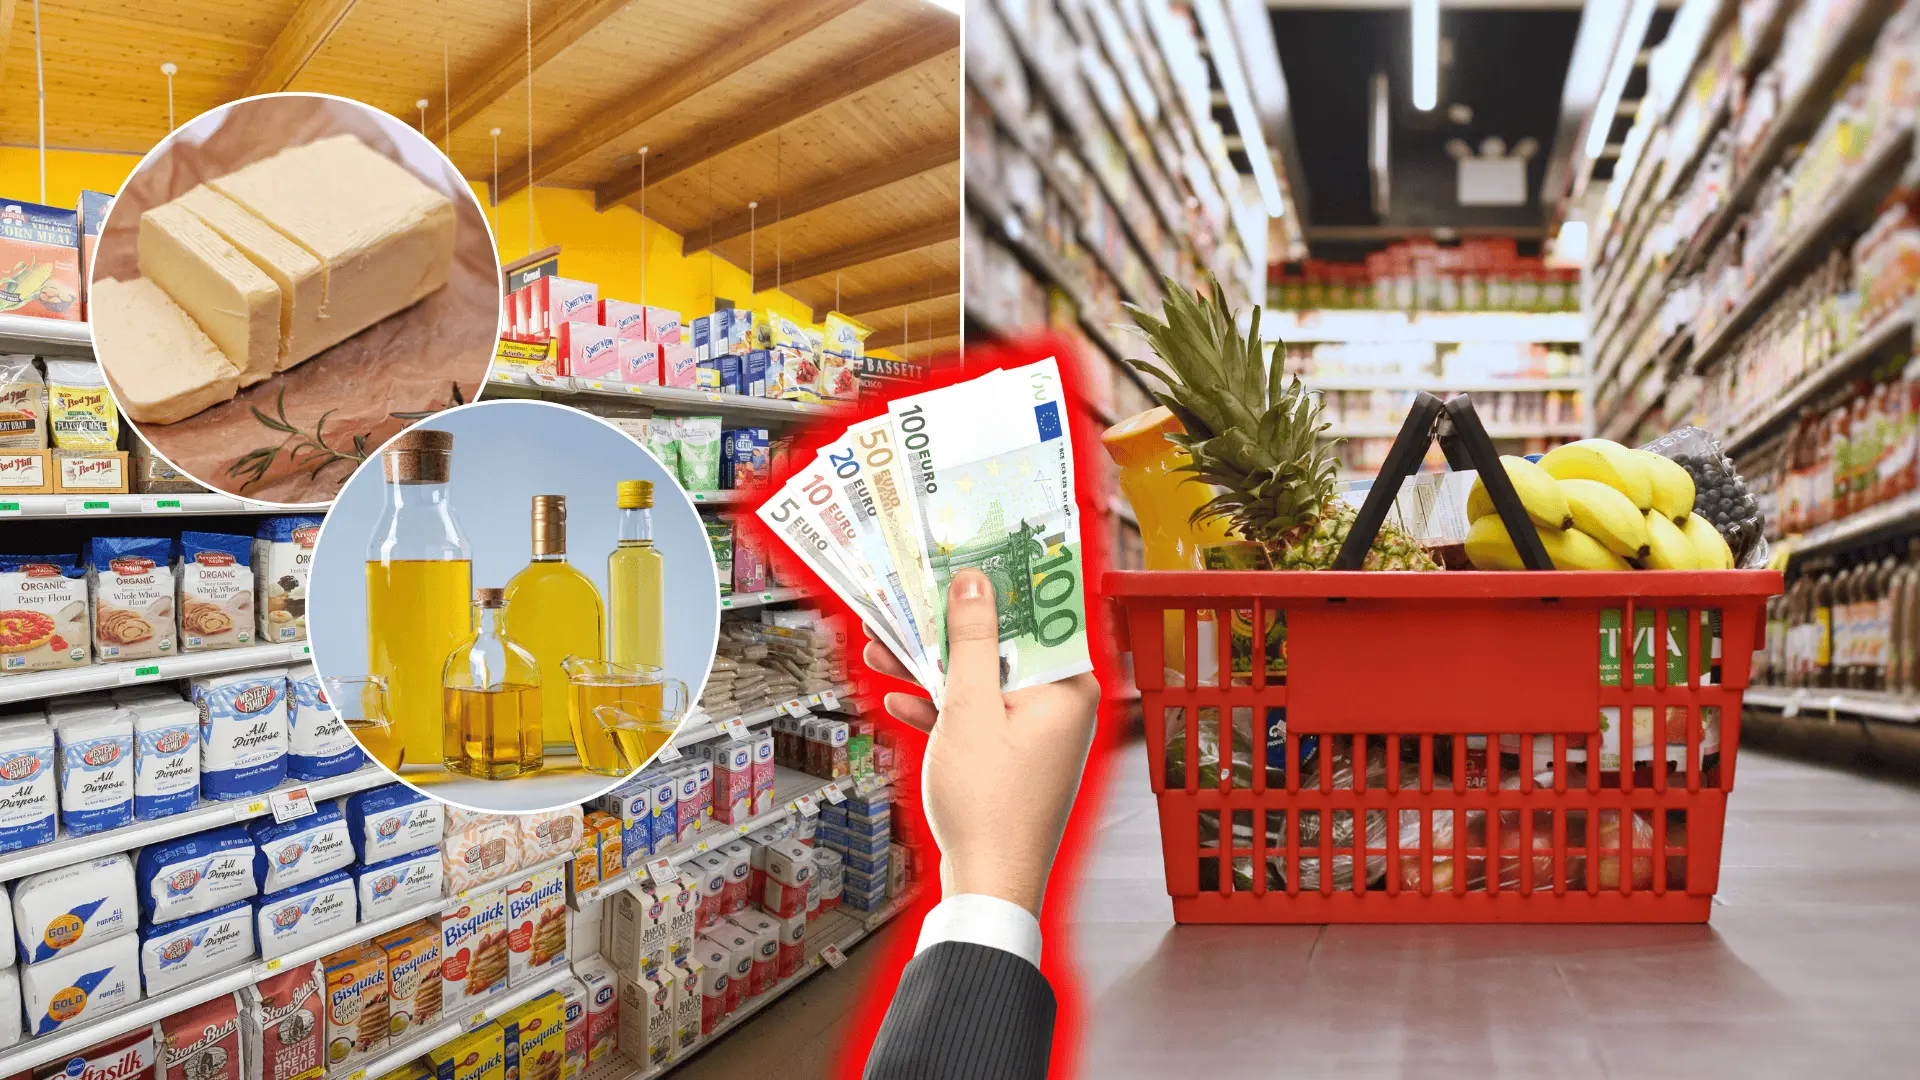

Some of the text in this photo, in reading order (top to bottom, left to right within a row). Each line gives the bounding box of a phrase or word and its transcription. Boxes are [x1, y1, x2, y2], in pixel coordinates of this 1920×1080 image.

[36, 230, 74, 246] MEAL
[866, 358, 924, 380] BASSETT
[67, 394, 101, 409] Red Mill
[899, 404, 938, 494] 100 EURO
[14, 457, 32, 471] Mill
[79, 460, 112, 477] Red Mill
[859, 428, 901, 508] 50 EURO
[829, 447, 878, 517] 20 EURO
[802, 474, 857, 540] 10 EURO
[770, 497, 828, 551] 5 EURO
[124, 564, 142, 572] Mills
[199, 570, 236, 579] ORGANIC
[21, 581, 67, 591] ORGANIC
[116, 575, 156, 586] ORGANIC
[113, 591, 161, 600] Whole Wheat
[197, 586, 218, 595] Whole
[1032, 545, 1078, 648] 100
[18, 593, 73, 605] Pastry Flour
[238, 685, 272, 703] WESTERN
[244, 693, 267, 713] FAMILY
[246, 722, 268, 738] All
[160, 731, 186, 747] WESTERN
[164, 738, 184, 753] FAMILY
[232, 731, 279, 749] Purpose
[87, 743, 116, 759] WESTERN
[92, 751, 113, 766] FAMILY
[4, 754, 35, 774] WESTERN
[165, 758, 184, 770] All
[9, 765, 33, 780] FAMILY
[94, 771, 113, 783] All
[154, 766, 193, 780] Purpose
[11, 785, 34, 798] All
[81, 780, 125, 794] Purpose
[0, 794, 47, 809] Purpose
[415, 809, 429, 820] All
[408, 817, 436, 829] Purpose
[319, 832, 333, 845] All
[310, 840, 343, 854] Purpose
[218, 858, 236, 870] All
[414, 866, 426, 876] All
[207, 868, 246, 880] Purpose
[406, 873, 434, 886] Purpose
[319, 893, 334, 906] All
[510, 878, 563, 920] Bisquick
[112, 907, 123, 916] ALL
[312, 900, 344, 916] Purpose
[520, 896, 554, 920] Heart Smart
[96, 914, 123, 927] PURPOSE
[444, 901, 505, 947] Bisquick
[670, 915, 694, 931] SUGAR
[48, 921, 79, 939] GOLD
[214, 922, 231, 936] All
[455, 920, 494, 947] Heart Smart
[642, 928, 667, 943] SUGAR
[203, 930, 241, 948] Purpose
[391, 945, 439, 982] Bisquick
[115, 981, 126, 989] ALL
[332, 969, 385, 1007] Bisquick
[393, 973, 420, 994] Gluten
[400, 984, 417, 999] Free
[99, 987, 126, 999] PURPOSE
[52, 994, 83, 1011] GOLD
[260, 980, 318, 1024] Stone-Buhr
[334, 997, 362, 1019] Gluten
[341, 1004, 360, 1025] Free
[164, 1018, 239, 1063] Stone-Buhr
[275, 1034, 316, 1056] UNBLEACHED
[521, 1019, 563, 1058] Bisquick
[275, 1041, 316, 1064] WHITE
[274, 1049, 316, 1073] BREAD
[274, 1058, 315, 1080] FLOUR
